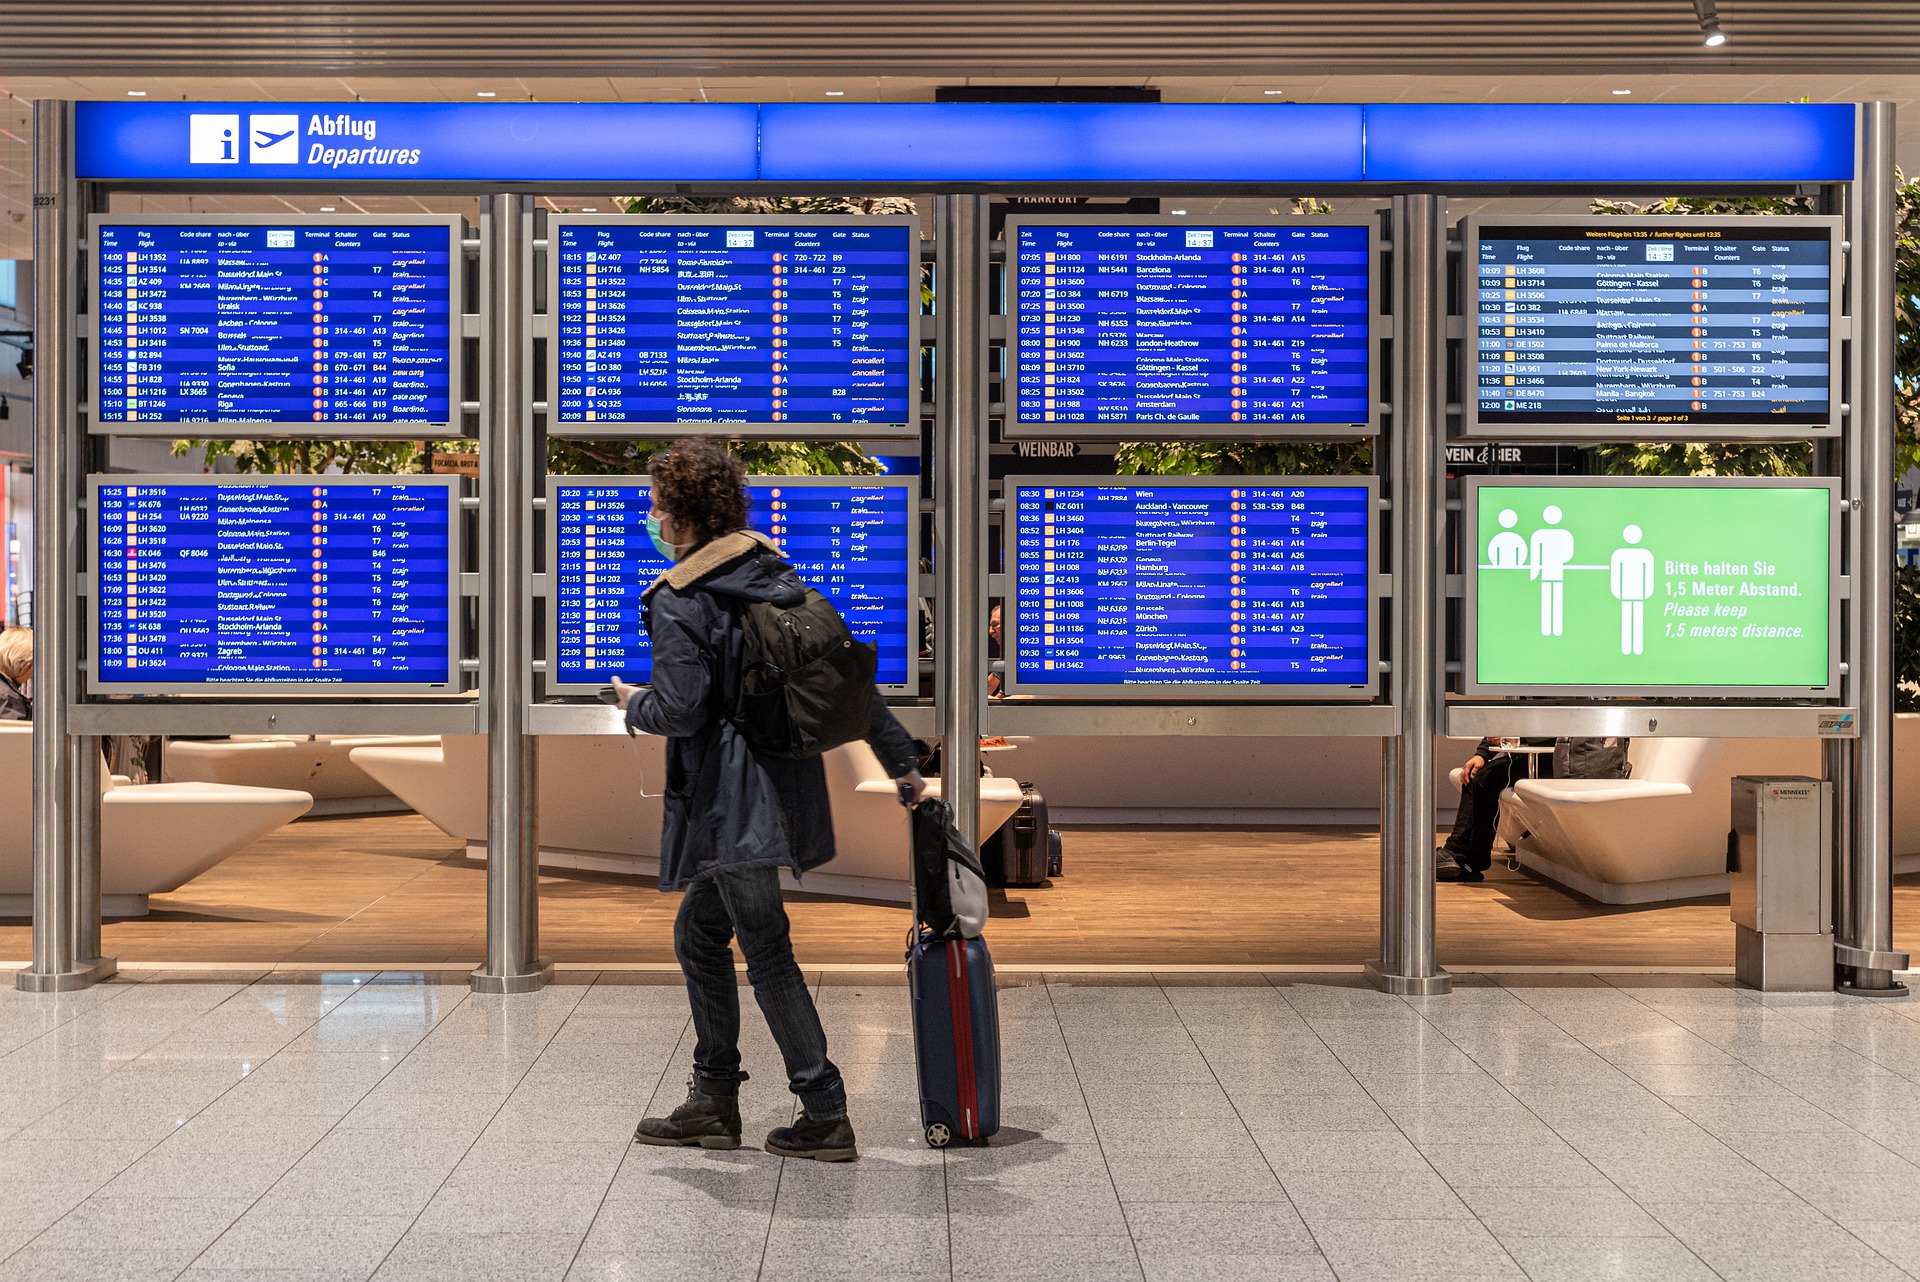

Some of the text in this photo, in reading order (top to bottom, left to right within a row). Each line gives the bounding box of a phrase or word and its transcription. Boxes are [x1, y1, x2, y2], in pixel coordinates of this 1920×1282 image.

[307, 114, 376, 141] Abflug
[307, 143, 421, 169] Departures
[1608, 231, 1623, 239] Flüge
[138, 240, 155, 248] Flight
[563, 253, 582, 261] 18:15
[597, 253, 607, 261] AZ
[608, 253, 621, 261] 407
[832, 266, 846, 274] Z23
[104, 302, 240, 310] 14:40 KC 938 Uralsk
[372, 327, 387, 335] A13
[1021, 339, 1041, 347] 08:00
[1110, 339, 1128, 347] 6233
[1752, 341, 1762, 349] B9
[103, 363, 122, 371] 14:55
[138, 363, 148, 371] FB
[218, 363, 235, 371] Sofia
[138, 400, 148, 408] BT
[149, 400, 166, 408] 1246
[218, 400, 233, 409] Riga
[1019, 441, 1074, 457] WEINBAR
[1477, 446, 1489, 465] &
[596, 490, 605, 498] JU
[103, 549, 122, 557] 16:30
[138, 549, 147, 557] EK
[148, 549, 161, 557] 046
[179, 549, 190, 558] QF
[190, 549, 208, 557] 8046
[1136, 564, 1169, 572] Hamburg
[1665, 561, 1775, 576] Bitte halten Sie
[1665, 581, 1802, 597] 1,5 Meter Abstand.
[1663, 602, 1747, 620] Please keep
[1020, 612, 1040, 620] 09:15
[1665, 623, 1804, 638] 1,5 meters distance.
[103, 647, 122, 655] 18:00
[138, 647, 150, 655] OU
[217, 647, 242, 656] Zagreb
[372, 647, 386, 655] B47
